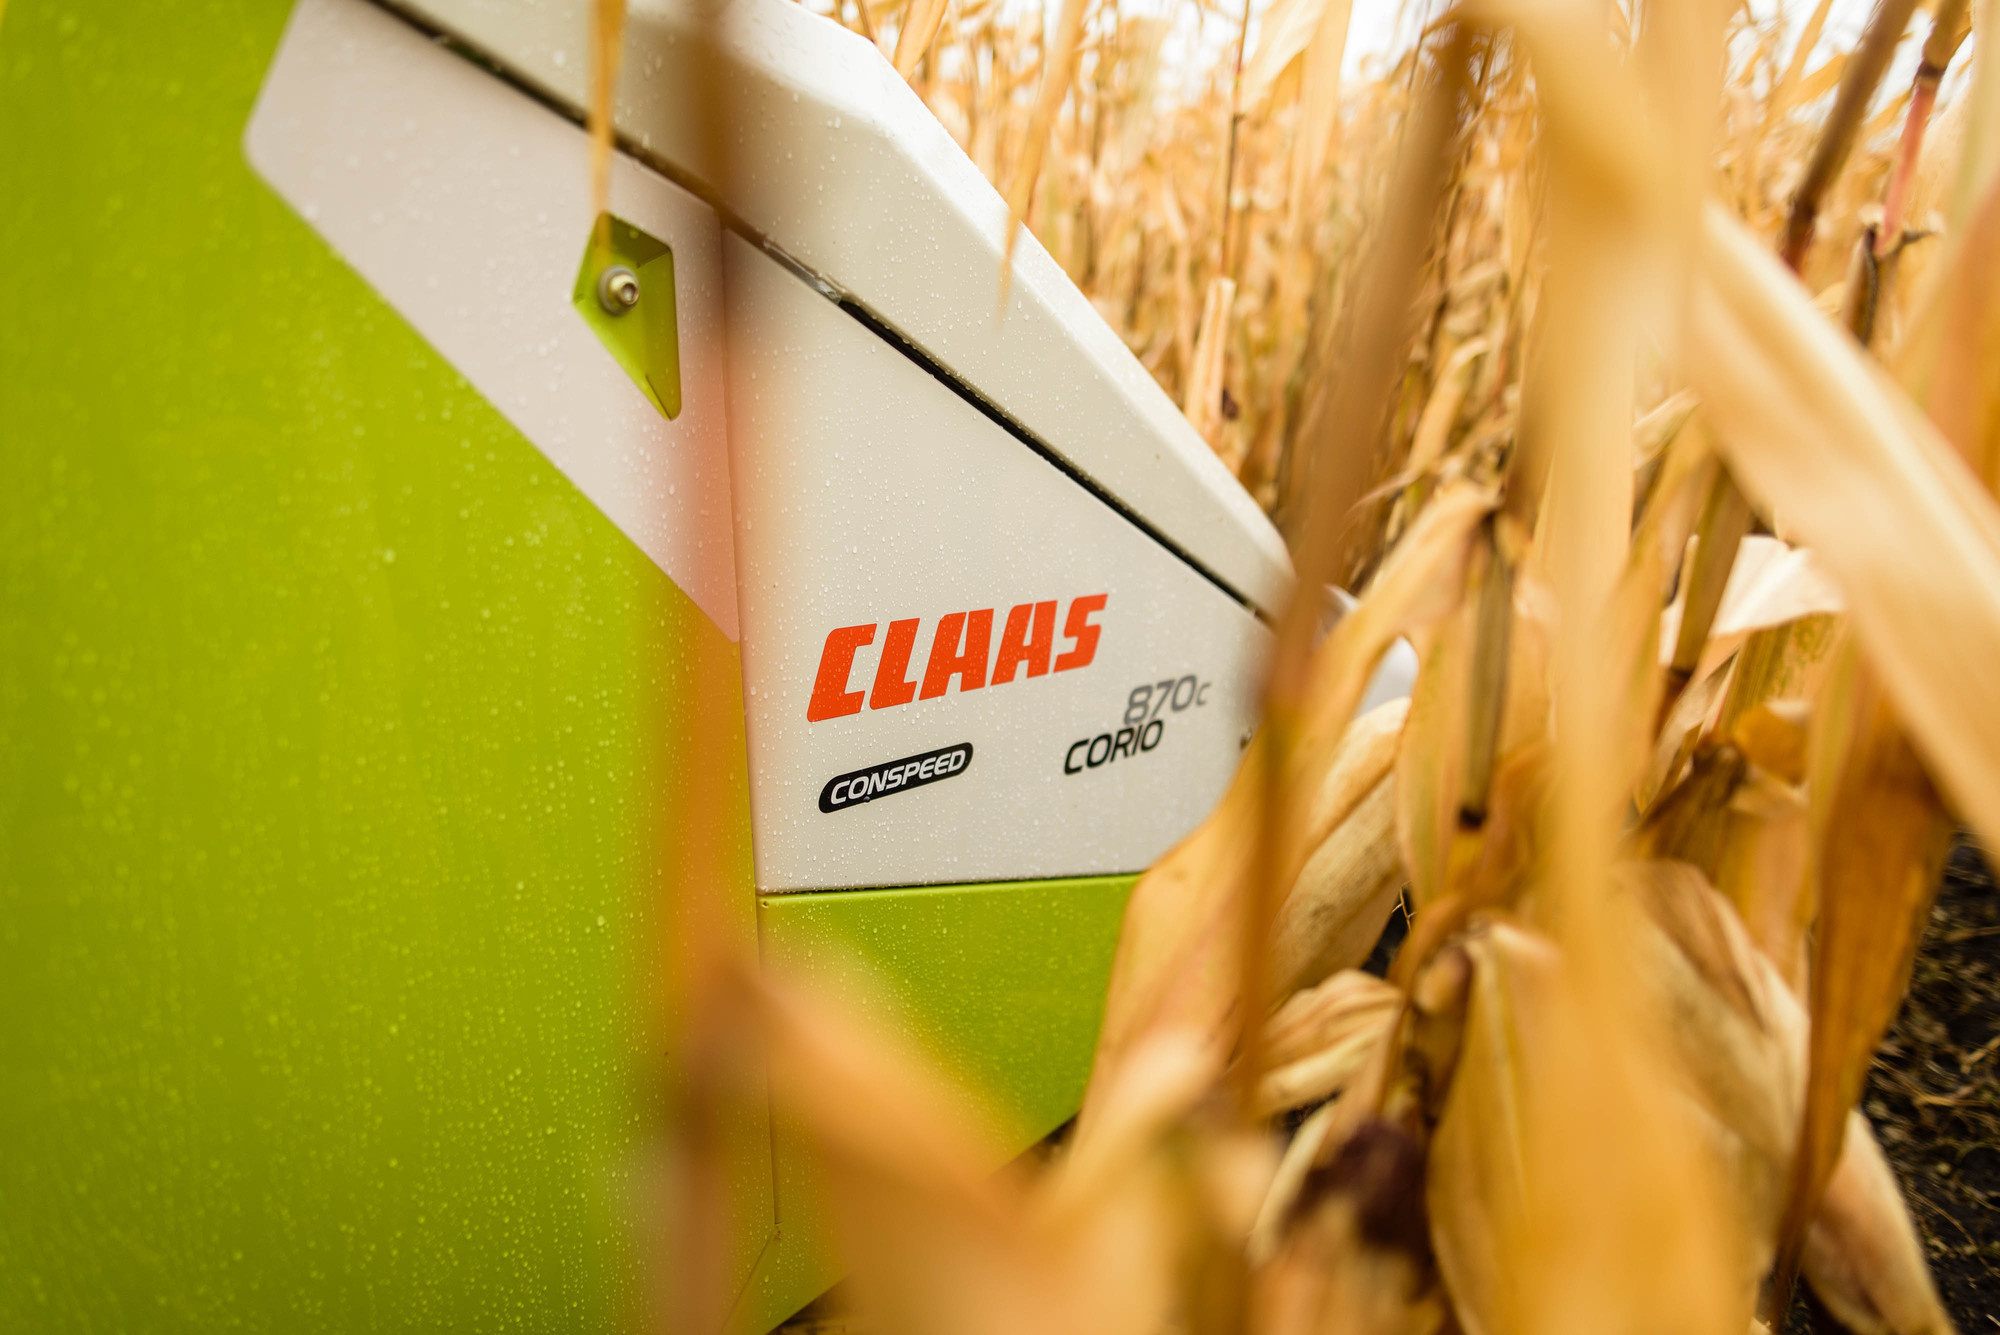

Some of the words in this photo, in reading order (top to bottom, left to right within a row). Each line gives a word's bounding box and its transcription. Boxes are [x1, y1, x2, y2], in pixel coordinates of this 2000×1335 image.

[807, 593, 1109, 722] CLAAS
[1063, 719, 1165, 776] CORIO
[830, 749, 967, 805] CONSPEED
